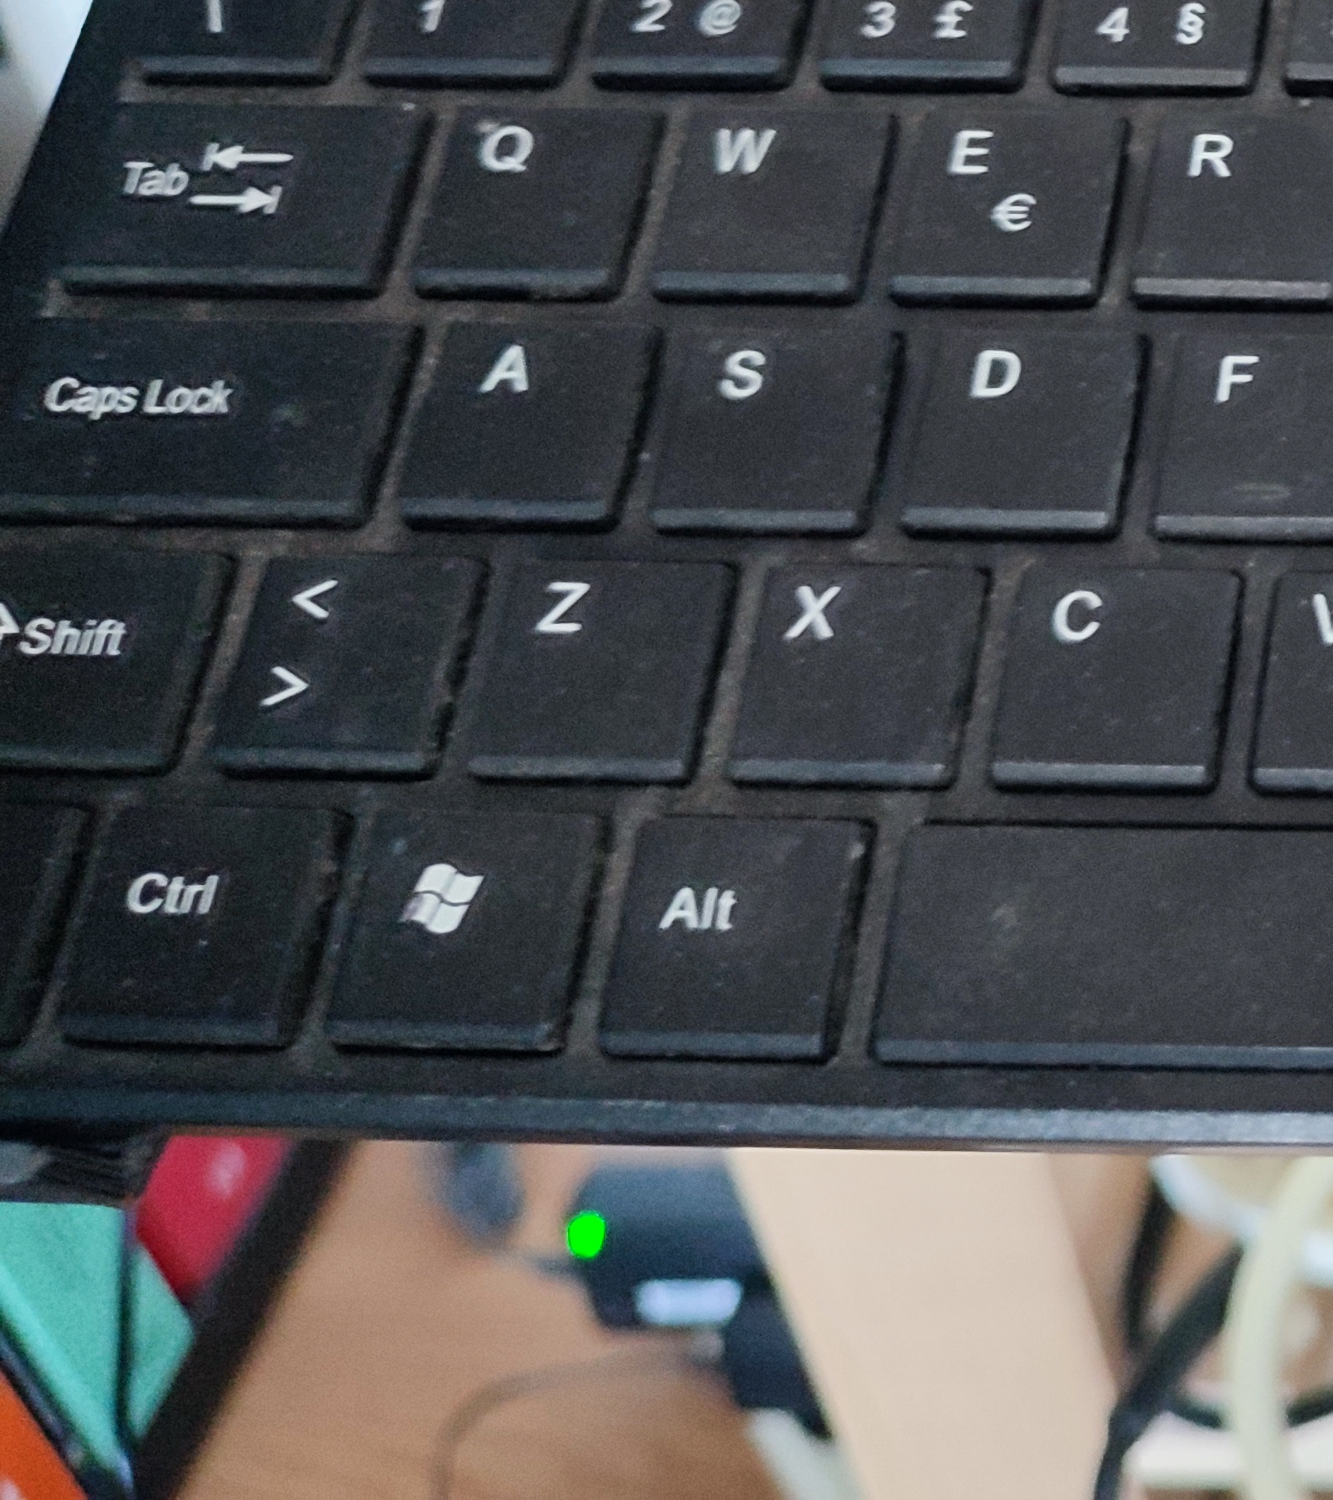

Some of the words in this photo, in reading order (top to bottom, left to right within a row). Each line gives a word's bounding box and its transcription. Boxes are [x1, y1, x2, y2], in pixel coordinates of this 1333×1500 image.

[860, 0, 898, 39] 3
[1095, 5, 1131, 44] 4
[479, 122, 535, 173] Q
[715, 127, 778, 175] W
[947, 128, 995, 176] E
[1187, 132, 1235, 179] R
[123, 159, 191, 198] Tab
[990, 191, 1038, 233] €
[478, 343, 530, 394] A
[719, 348, 767, 400] S
[969, 348, 1023, 399] D
[1215, 353, 1261, 404] F
[43, 375, 141, 421] Caps
[141, 378, 234, 415] Lock
[534, 580, 592, 635] Z
[784, 584, 843, 641] X
[1051, 588, 1104, 643] C
[18, 616, 128, 657] Shift
[125, 871, 221, 916] Ctrl
[658, 885, 738, 933] Alt
